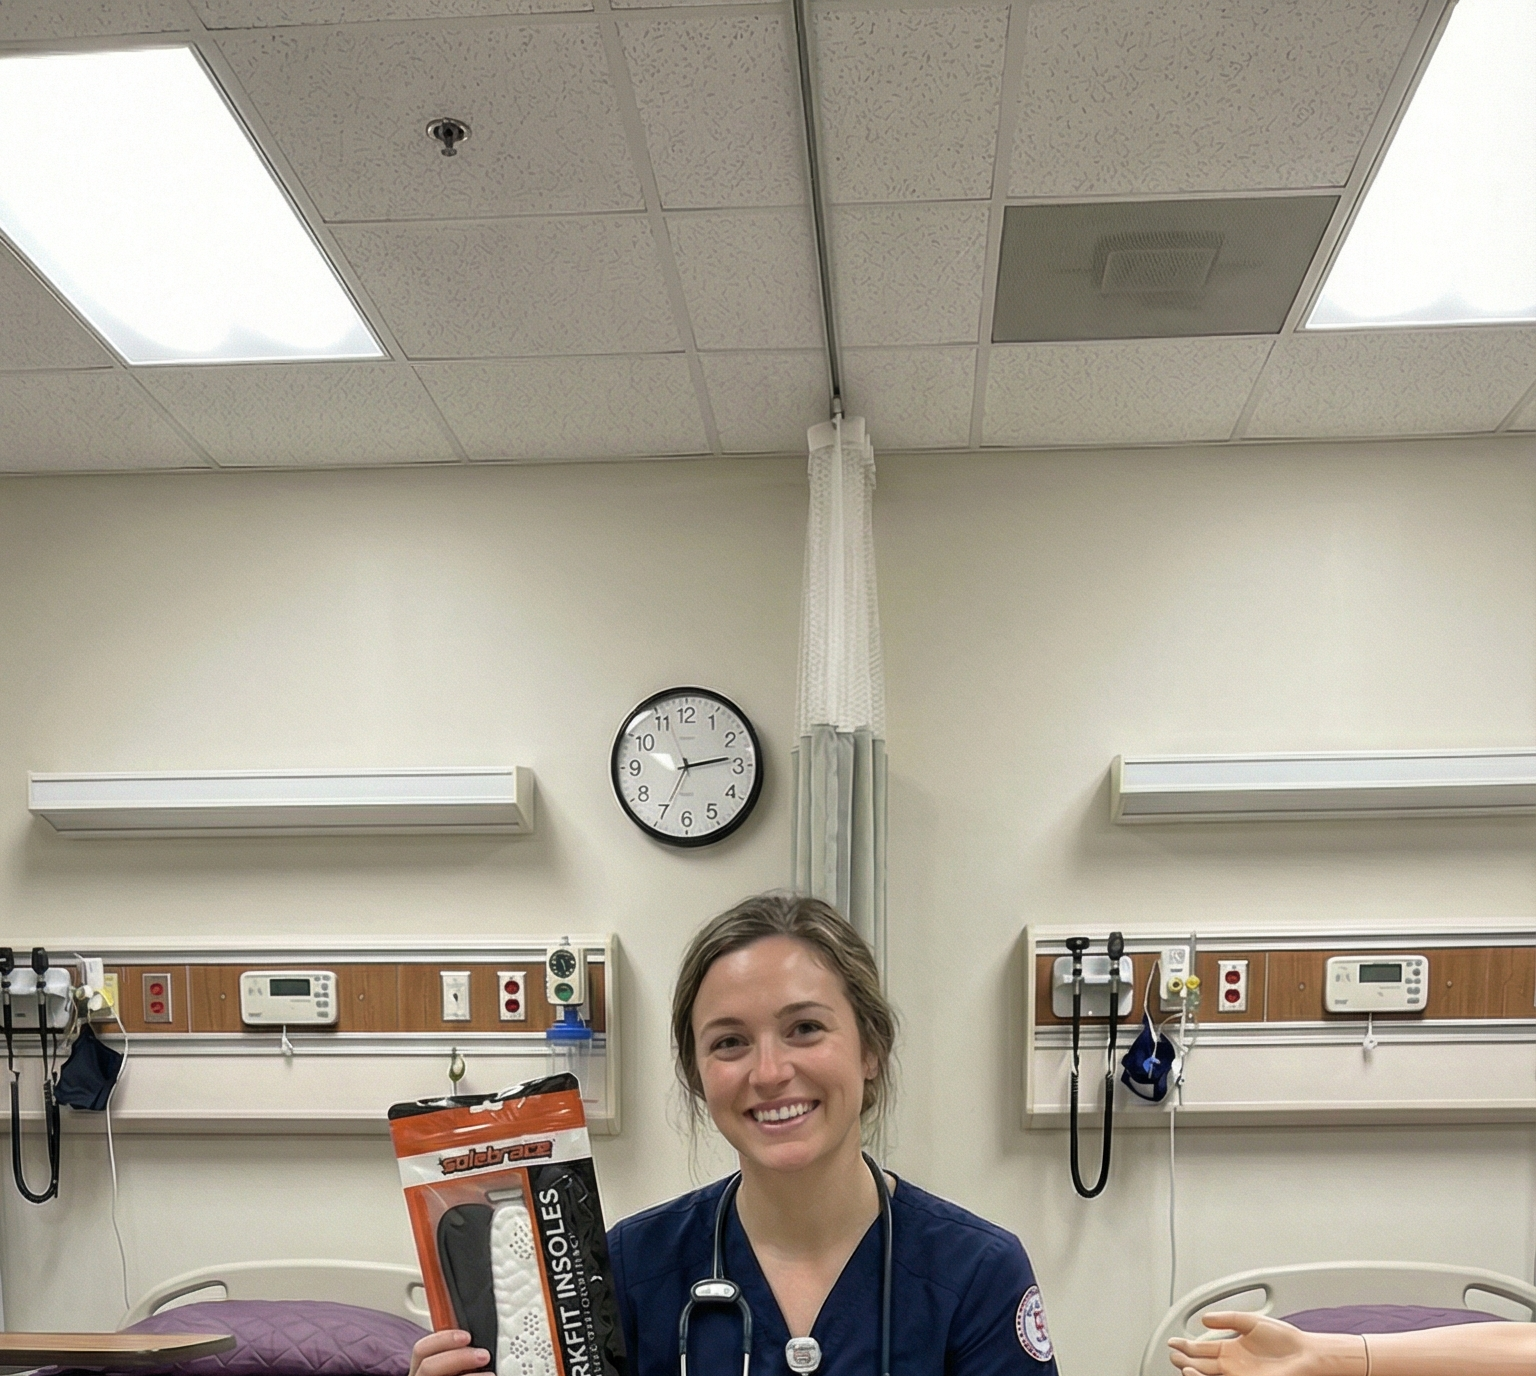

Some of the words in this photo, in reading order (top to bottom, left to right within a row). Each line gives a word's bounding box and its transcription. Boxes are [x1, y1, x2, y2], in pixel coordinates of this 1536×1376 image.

[655, 715, 670, 732] 11
[677, 706, 696, 724] 12
[708, 714, 715, 731] 1
[635, 733, 655, 752] 10
[725, 731, 736, 748] 2
[629, 759, 642, 777] 9
[732, 757, 745, 775] 3
[637, 785, 650, 803] 8
[725, 784, 736, 799] 4
[657, 803, 670, 820] 7
[681, 811, 693, 828] 6
[706, 803, 718, 820] 5
[538, 1188, 577, 1299] INSOLES
